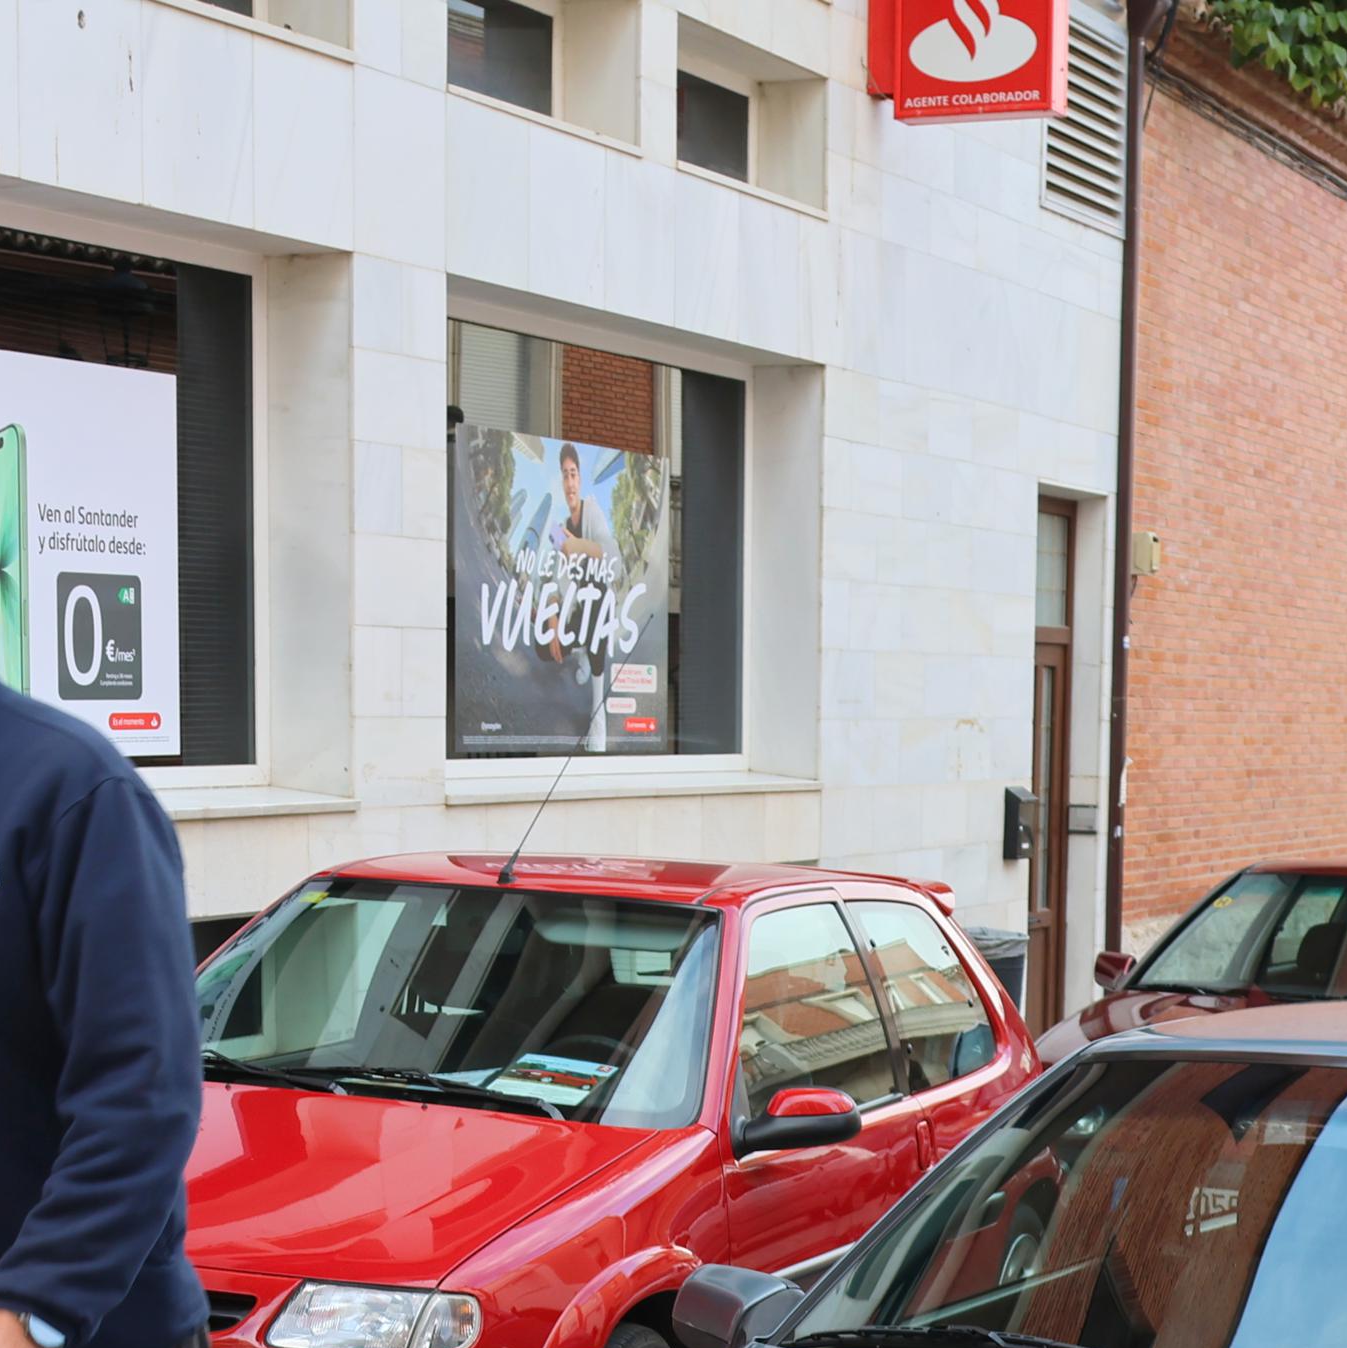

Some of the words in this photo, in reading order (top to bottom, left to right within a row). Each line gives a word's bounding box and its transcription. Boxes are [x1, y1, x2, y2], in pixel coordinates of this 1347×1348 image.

[904, 95, 949, 109] AGENTE
[952, 90, 1041, 106] COLABORADOR
[38, 503, 61, 523] Ven
[64, 505, 75, 524] al
[78, 506, 138, 528] Santander
[38, 536, 46, 555] y
[48, 531, 105, 553] disfrútalo
[109, 536, 146, 555] desde:
[516, 547, 536, 574] NO
[537, 550, 556, 577] LE
[557, 551, 587, 580] DES
[481, 578, 647, 658] VUELTAS
[64, 584, 103, 686] 0
